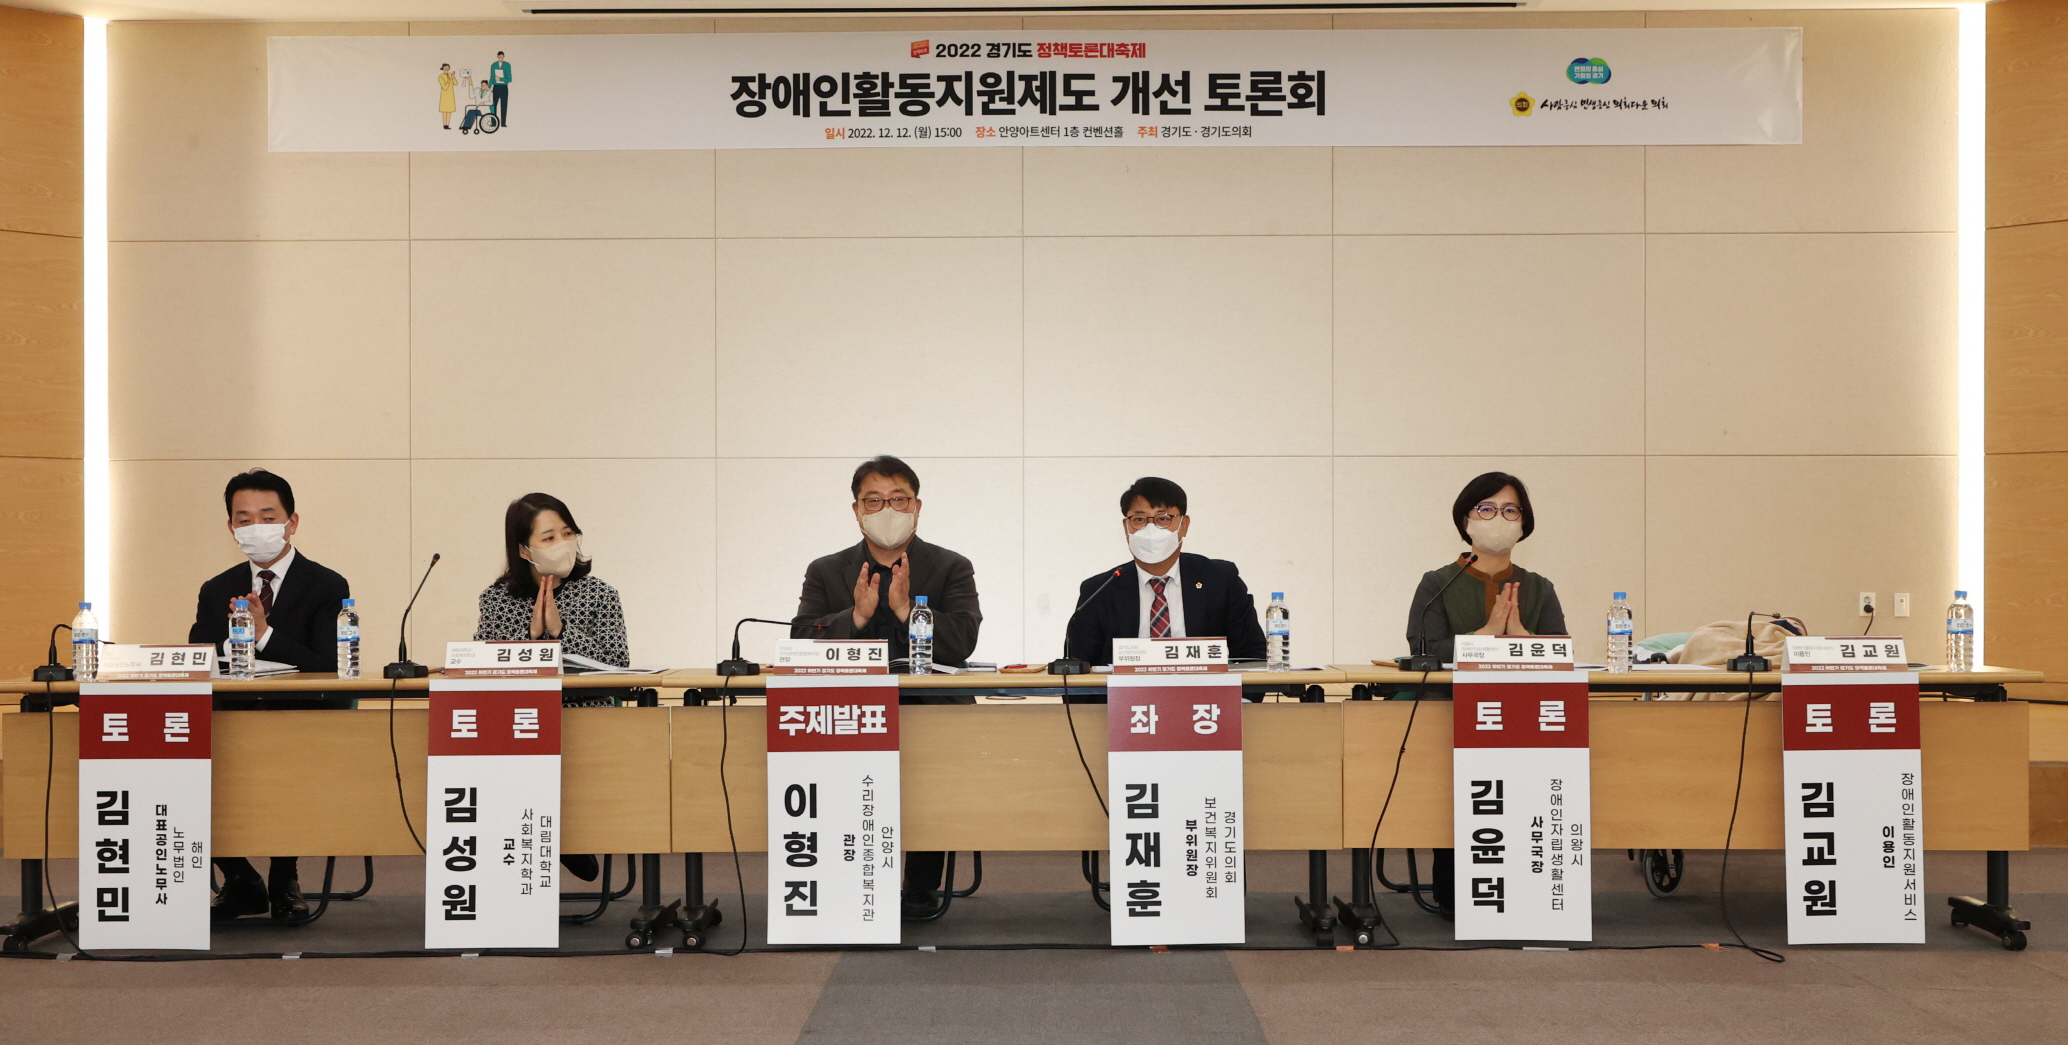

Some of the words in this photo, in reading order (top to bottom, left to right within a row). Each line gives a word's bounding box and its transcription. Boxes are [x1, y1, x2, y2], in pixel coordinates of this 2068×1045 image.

[936, 44, 981, 57] 2022
[986, 43, 1032, 58] 경기도
[1036, 43, 1146, 58] 정책토론대축제
[730, 71, 1099, 118] 장애인활동지원제도
[1111, 71, 1191, 115] 개선
[1204, 71, 1325, 116] 토론회
[825, 128, 845, 140] 일시
[848, 128, 876, 139] 2022.
[879, 128, 894, 138] 12.
[897, 128, 912, 138] 12.
[915, 126, 932, 140] (월)
[935, 128, 963, 138] 15:00
[976, 126, 997, 139] 장소
[999, 126, 1060, 138] 안양아트센터
[1064, 126, 1080, 138] 1층
[1083, 126, 1124, 138] 컨벤션홀
[1138, 126, 1158, 139] 주최
[1162, 126, 1192, 138] 경기도
[1201, 126, 1252, 138] 경기도의회
[779, 705, 887, 736] 주제발표
[96, 791, 129, 922] 김현민
[156, 805, 167, 904] 대표공인노무사
[173, 827, 184, 882] 노무법인
[192, 842, 202, 868] 해인
[443, 788, 477, 920] 김성원
[503, 839, 515, 865] 교수
[521, 809, 533, 895] 사회복지학과
[540, 816, 551, 887] 대림대학교
[784, 784, 817, 916] 이형진
[844, 835, 855, 861] 관장
[863, 775, 874, 921] 수리장애인종합복지관
[882, 827, 893, 868] 안양시
[1126, 783, 1161, 917] 김재훈
[1186, 820, 1198, 876] 부위원장
[1205, 797, 1217, 898] 보건복지위원회
[1225, 812, 1236, 883] 경기도의회
[1471, 780, 1505, 913] 김윤덕
[1531, 816, 1543, 873] 사무국장
[1551, 779, 1563, 910] 장애인자립생활센터
[1571, 824, 1583, 866] 의왕시
[1802, 782, 1837, 916] 김교원
[1883, 826, 1895, 868] 이용인
[1902, 773, 1917, 920] 장애인활동지원서비스
